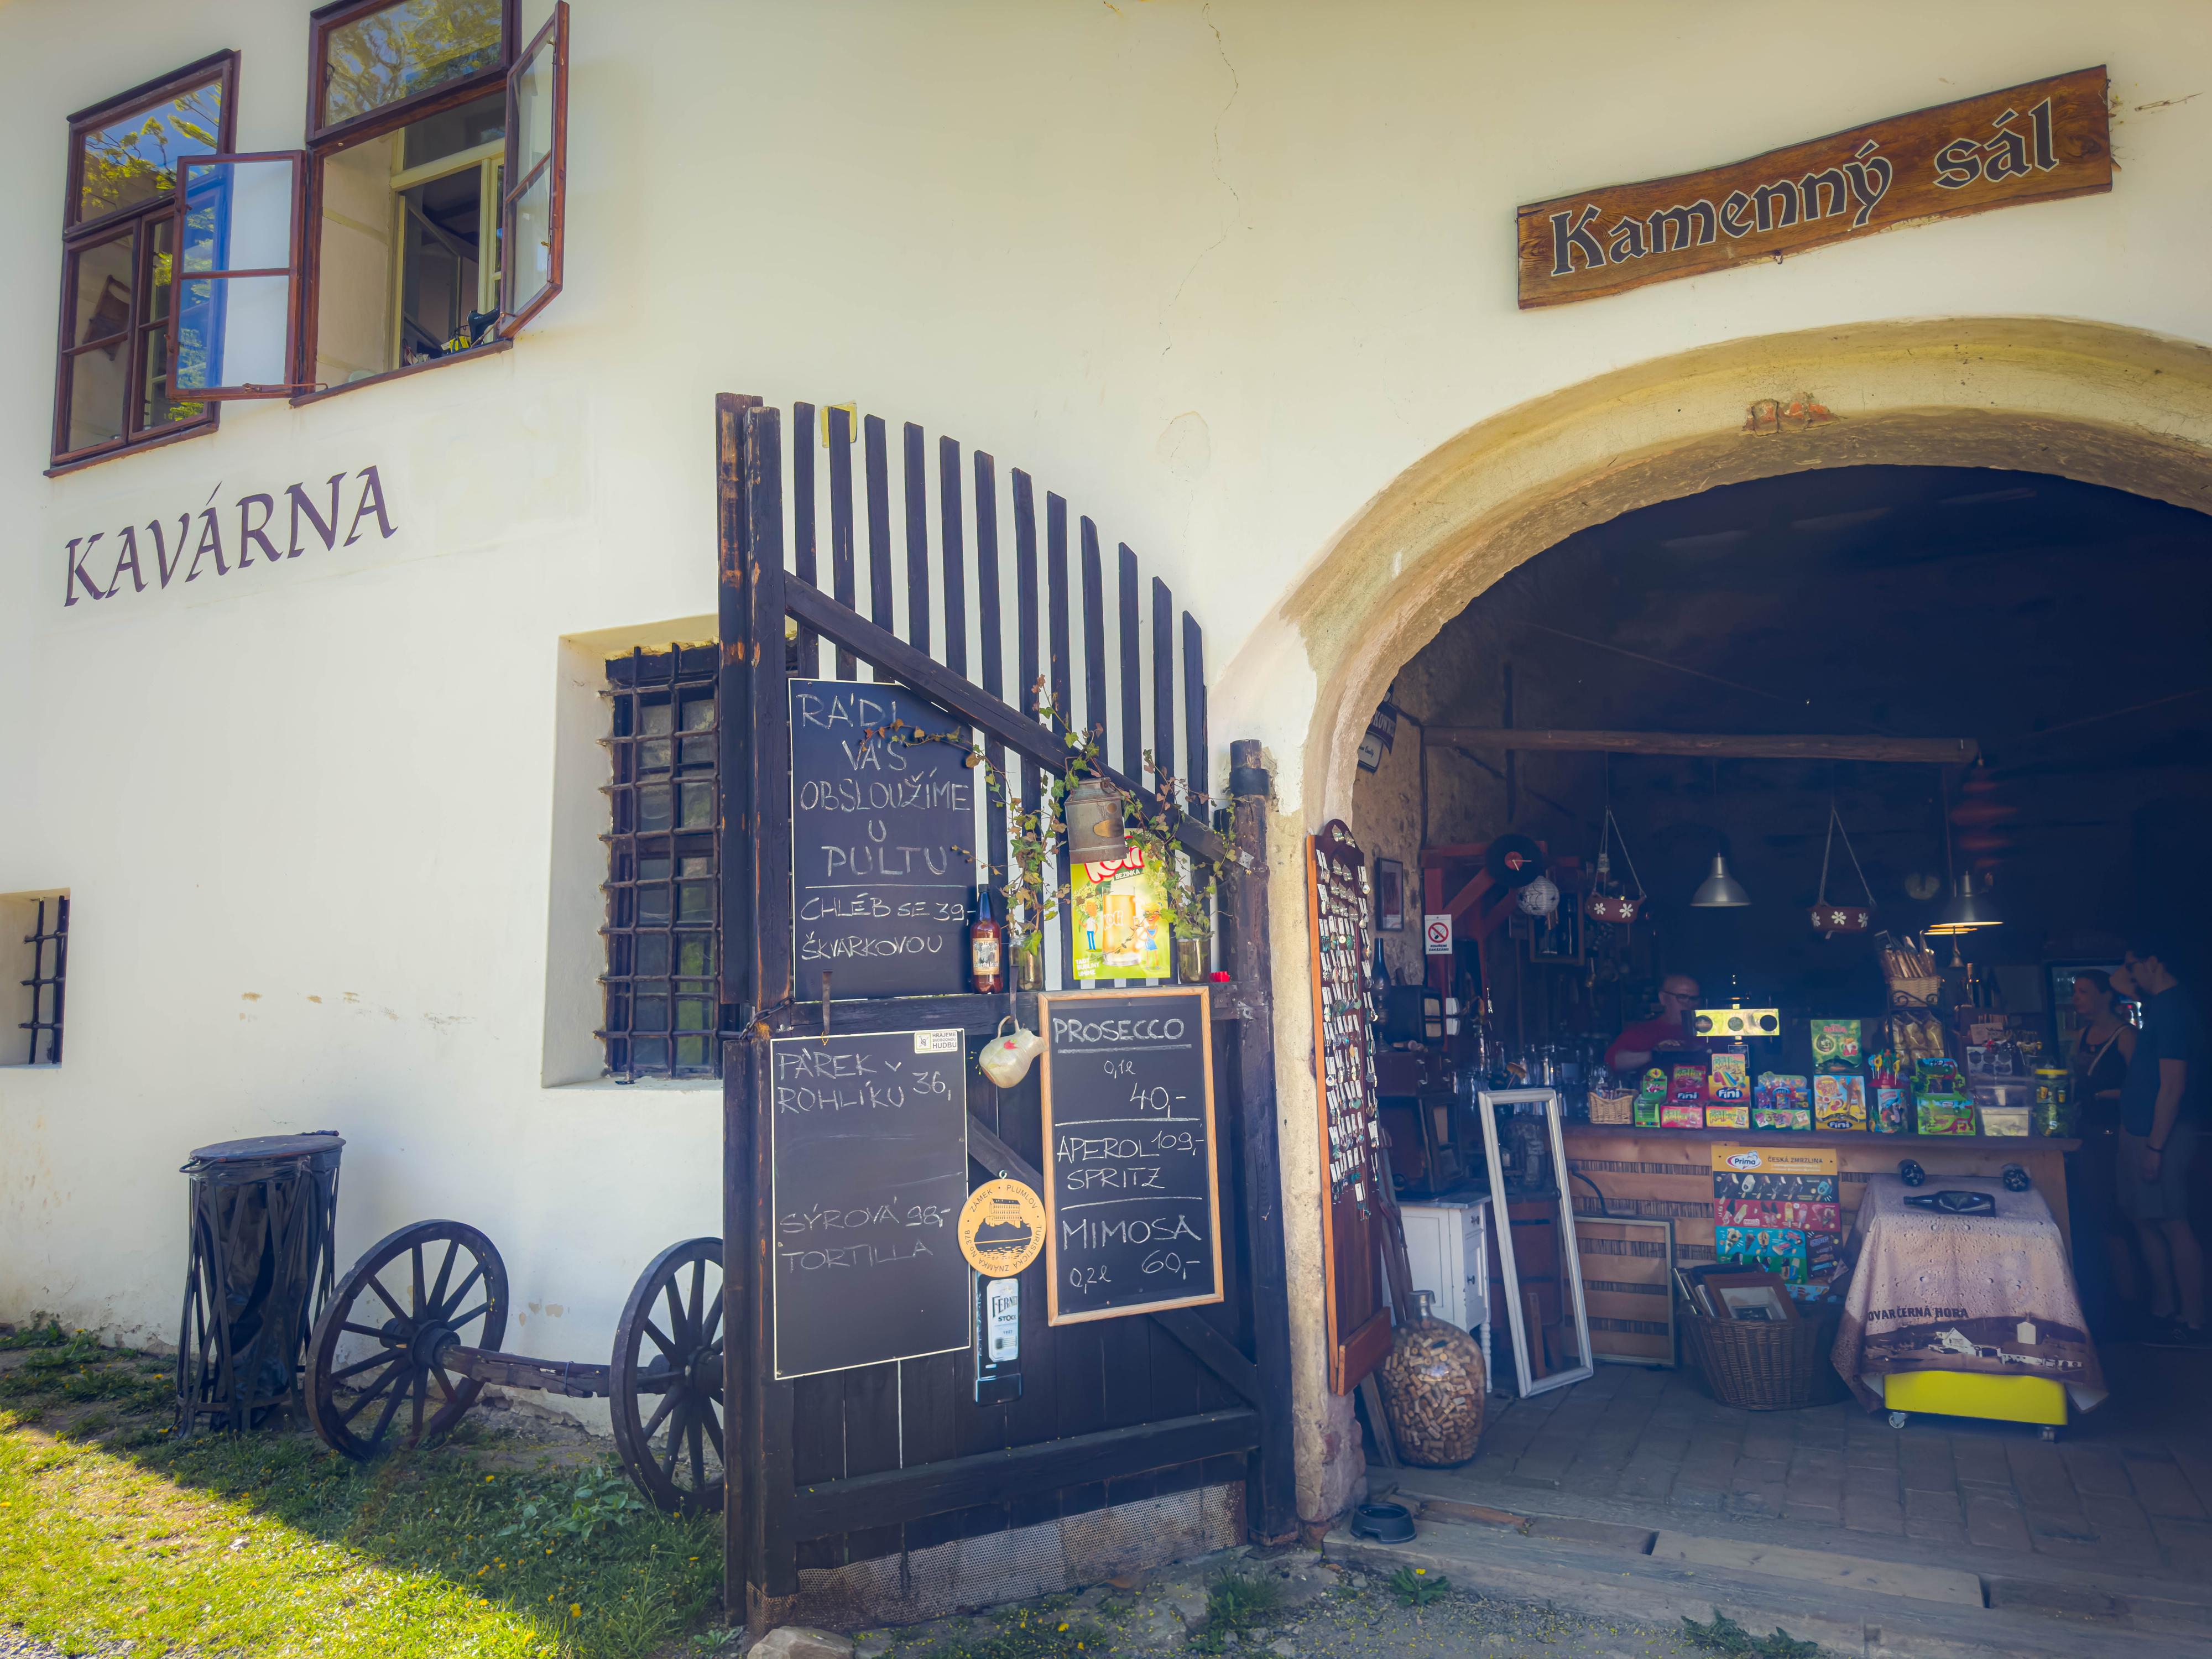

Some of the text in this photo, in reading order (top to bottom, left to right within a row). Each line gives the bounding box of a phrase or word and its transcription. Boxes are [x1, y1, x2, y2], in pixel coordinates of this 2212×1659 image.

[1549, 97, 2058, 276] Kamenný sál
[64, 465, 398, 607] KAVÁRNA
[842, 739, 907, 770] VÁS
[801, 767, 971, 811] OBSLOUŽÍME
[868, 820, 886, 842] U
[821, 846, 947, 877] PULTU
[1115, 868, 1140, 880] BEZINKA
[801, 893, 891, 921] CHLÉB
[898, 902, 930, 917] SE
[801, 931, 942, 960] ŠKVARKOVOU
[1052, 1018, 1185, 1044] PROSECCO
[776, 1048, 877, 1081] PÁREK
[778, 1080, 904, 1114] ROHLÍKU
[1129, 1082, 1187, 1119] 40,-
[1057, 1135, 1160, 1164] APEROL
[1067, 1167, 1165, 1190] SPRITZ
[1006, 1185, 1037, 1209] PLUMLOV
[780, 1196, 899, 1233] SÝROVÁ
[1013, 1225, 1042, 1269] TURISTICKÁ
[1063, 1215, 1202, 1250] MIMOSA
[781, 1239, 933, 1273] TORTILLA
[978, 1258, 1009, 1273] ZNÁMKA
[1897, 1305, 1932, 1318] ČERNÁ
[1934, 1307, 1969, 1318] HORA
